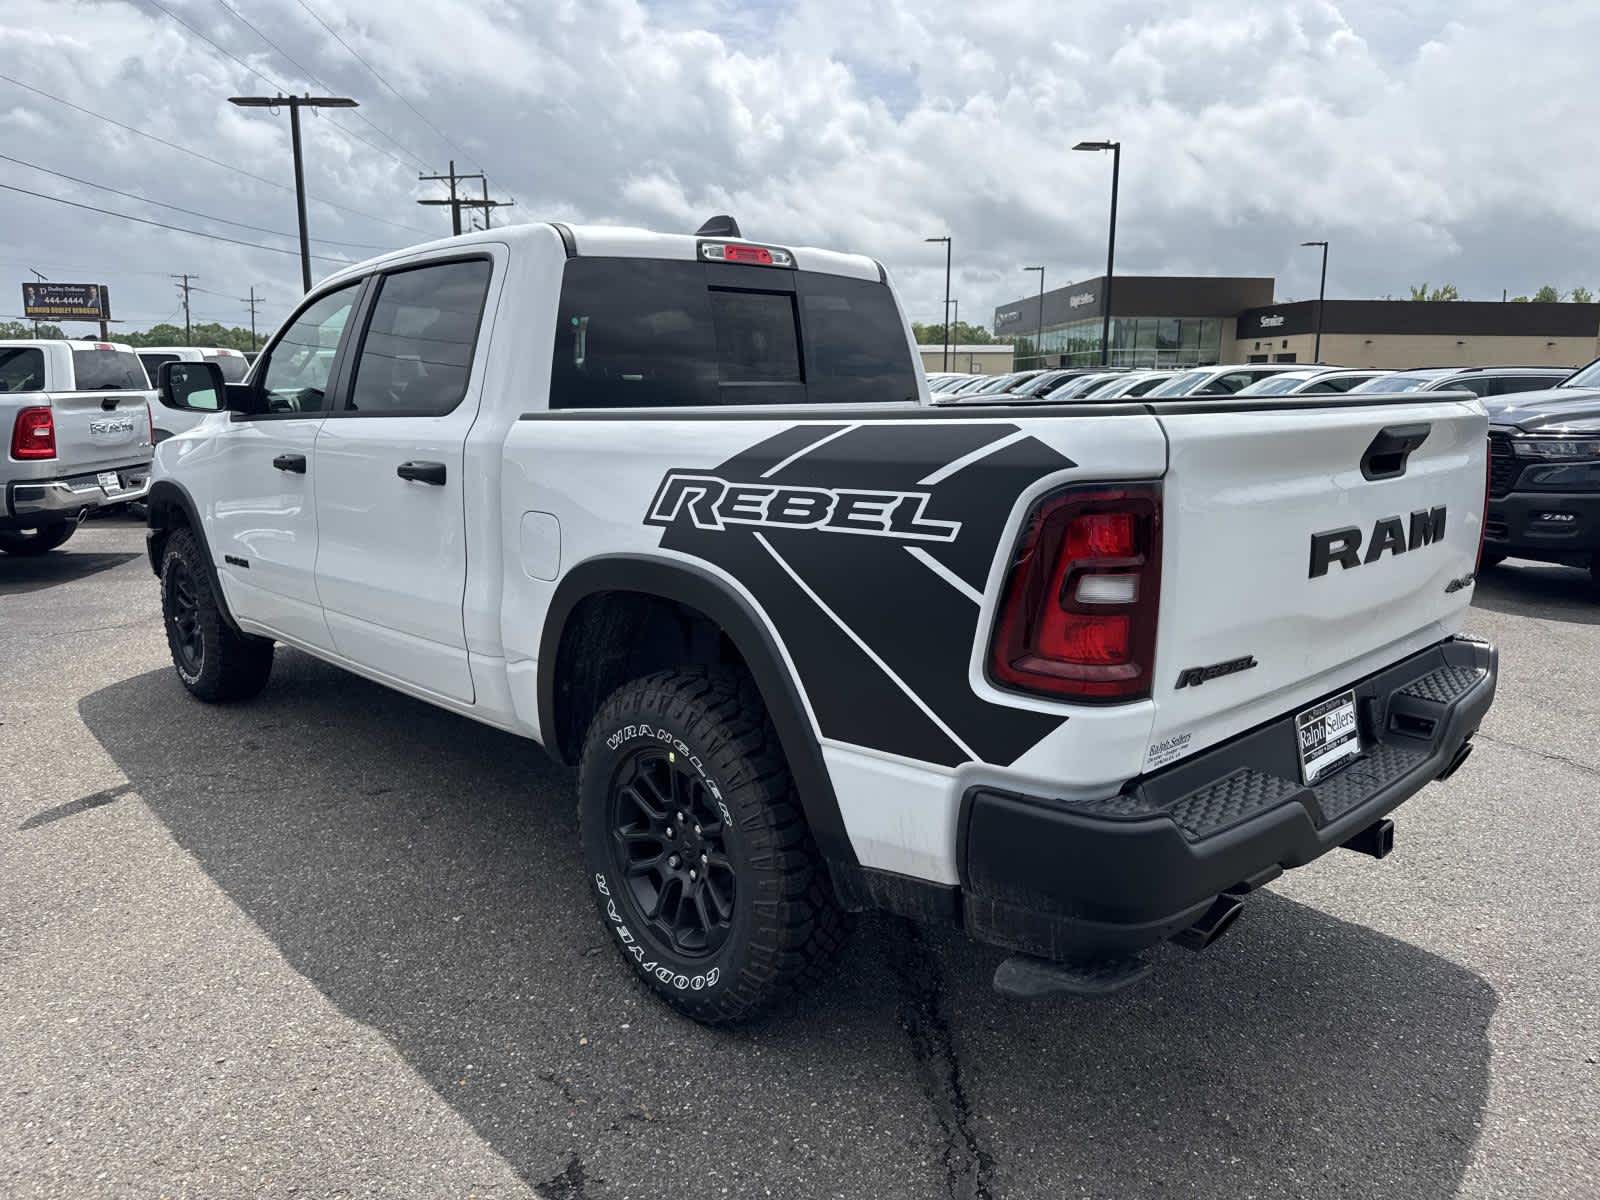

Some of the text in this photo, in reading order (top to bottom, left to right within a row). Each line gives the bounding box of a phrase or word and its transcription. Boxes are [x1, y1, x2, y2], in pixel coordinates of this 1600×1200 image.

[44, 296, 84, 305] 444-4444
[89, 421, 134, 435] RAM
[645, 470, 963, 543] REBEL
[1308, 504, 1447, 580] RAM
[1174, 655, 1258, 690] REBEL
[1299, 710, 1355, 750] Ralph Sellers
[607, 724, 733, 827] WRANGLER
[595, 873, 720, 991] GOODYEAR
